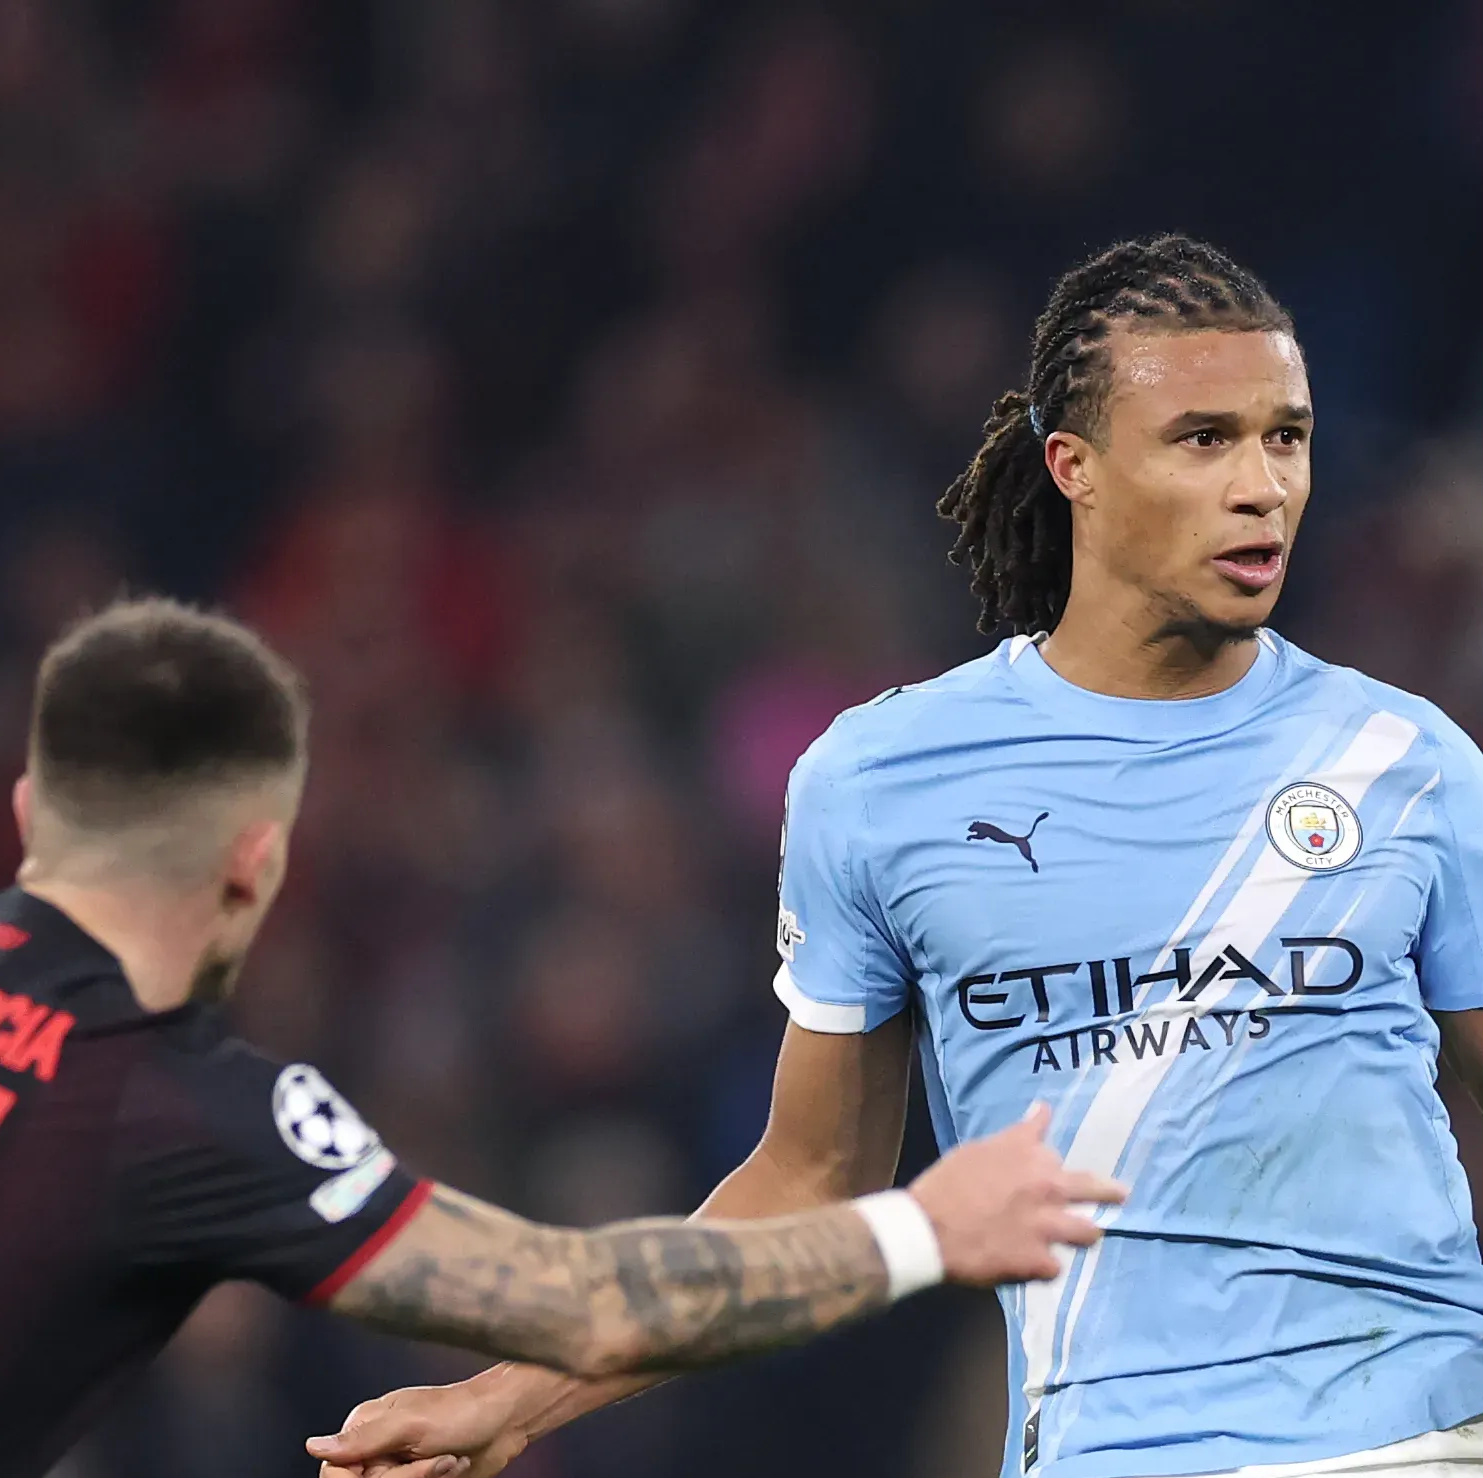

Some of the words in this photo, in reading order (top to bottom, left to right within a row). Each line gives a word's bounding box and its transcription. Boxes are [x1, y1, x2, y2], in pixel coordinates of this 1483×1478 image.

[1275, 789, 1349, 818] MANCHESTER
[1305, 857, 1333, 865] CITY
[957, 937, 1364, 1031] ETIHAD
[1032, 1010, 1272, 1074] AIRWAYS
